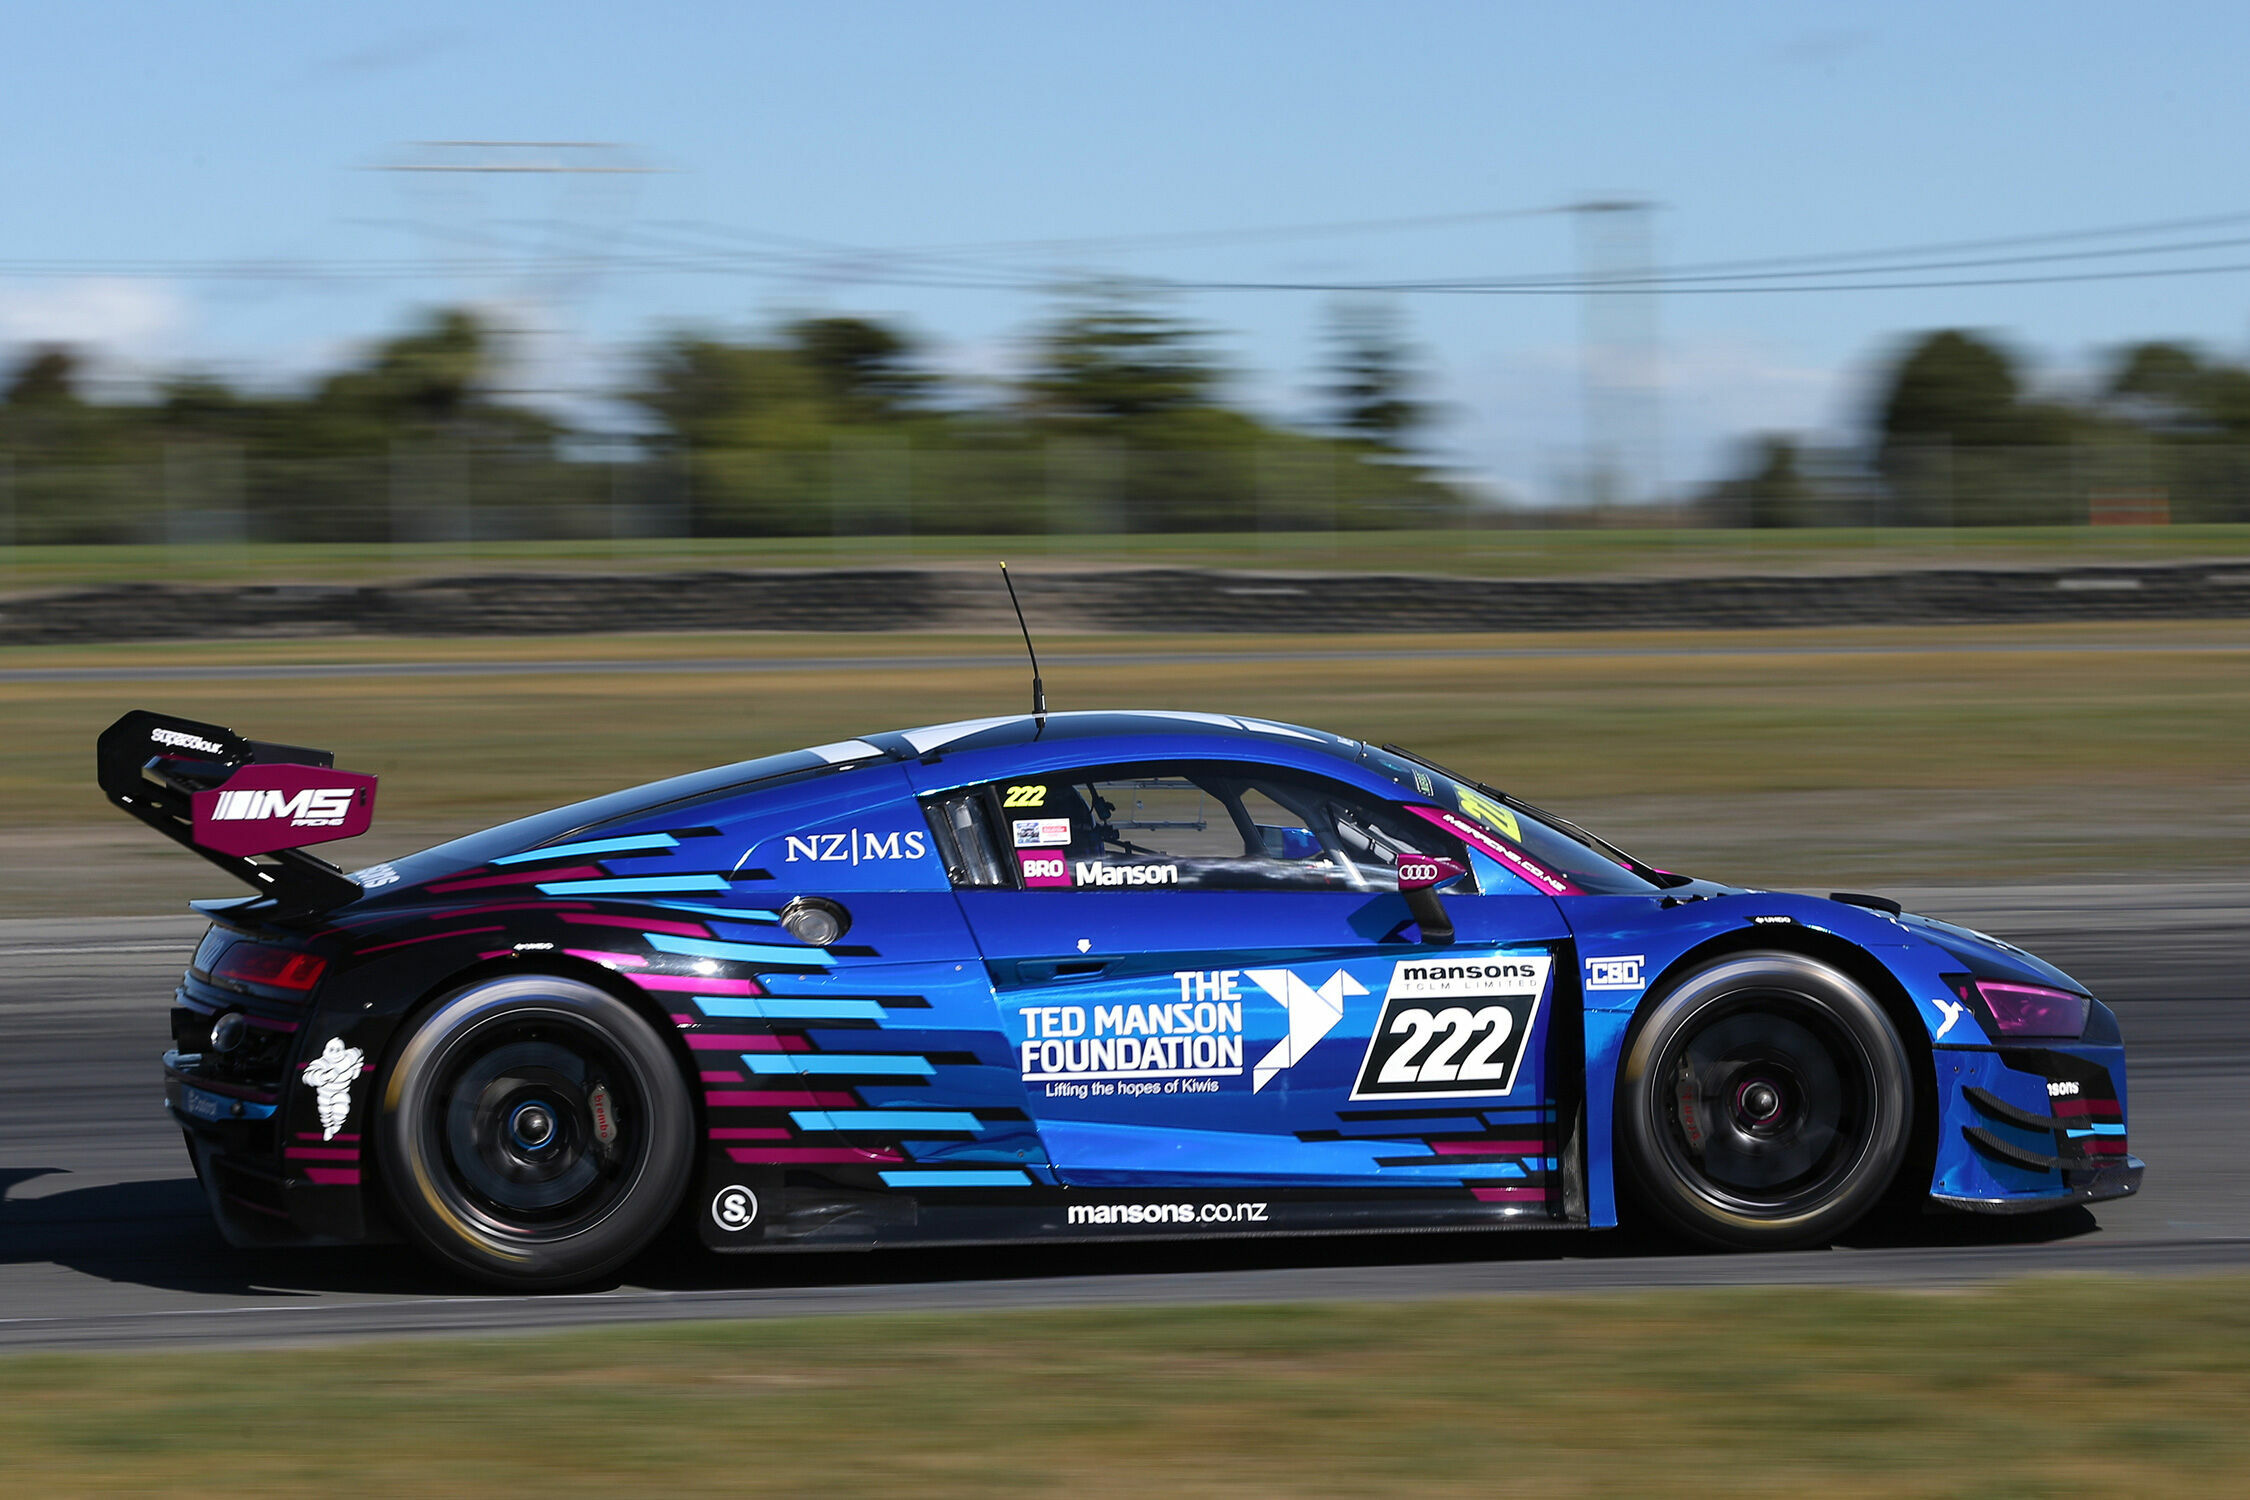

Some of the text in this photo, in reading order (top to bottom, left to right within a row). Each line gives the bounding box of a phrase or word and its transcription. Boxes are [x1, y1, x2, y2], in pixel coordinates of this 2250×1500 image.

[1003, 785, 1047, 808] 222
[1022, 858, 1064, 879] BRO
[1076, 860, 1178, 887] Manson
[1403, 964, 1536, 981] mansons
[1465, 979, 1538, 989] LIMITED
[1172, 970, 1243, 1002] THE
[1018, 1001, 1243, 1039] TED MANSON
[1021, 1035, 1243, 1073] FOUNDATION
[1377, 1006, 1513, 1084] 222
[1045, 1078, 1220, 1100] Lifting the hopes of Kiwis
[594, 1093, 609, 1138] brembo
[1068, 1203, 1268, 1224] mansons.co.nz
